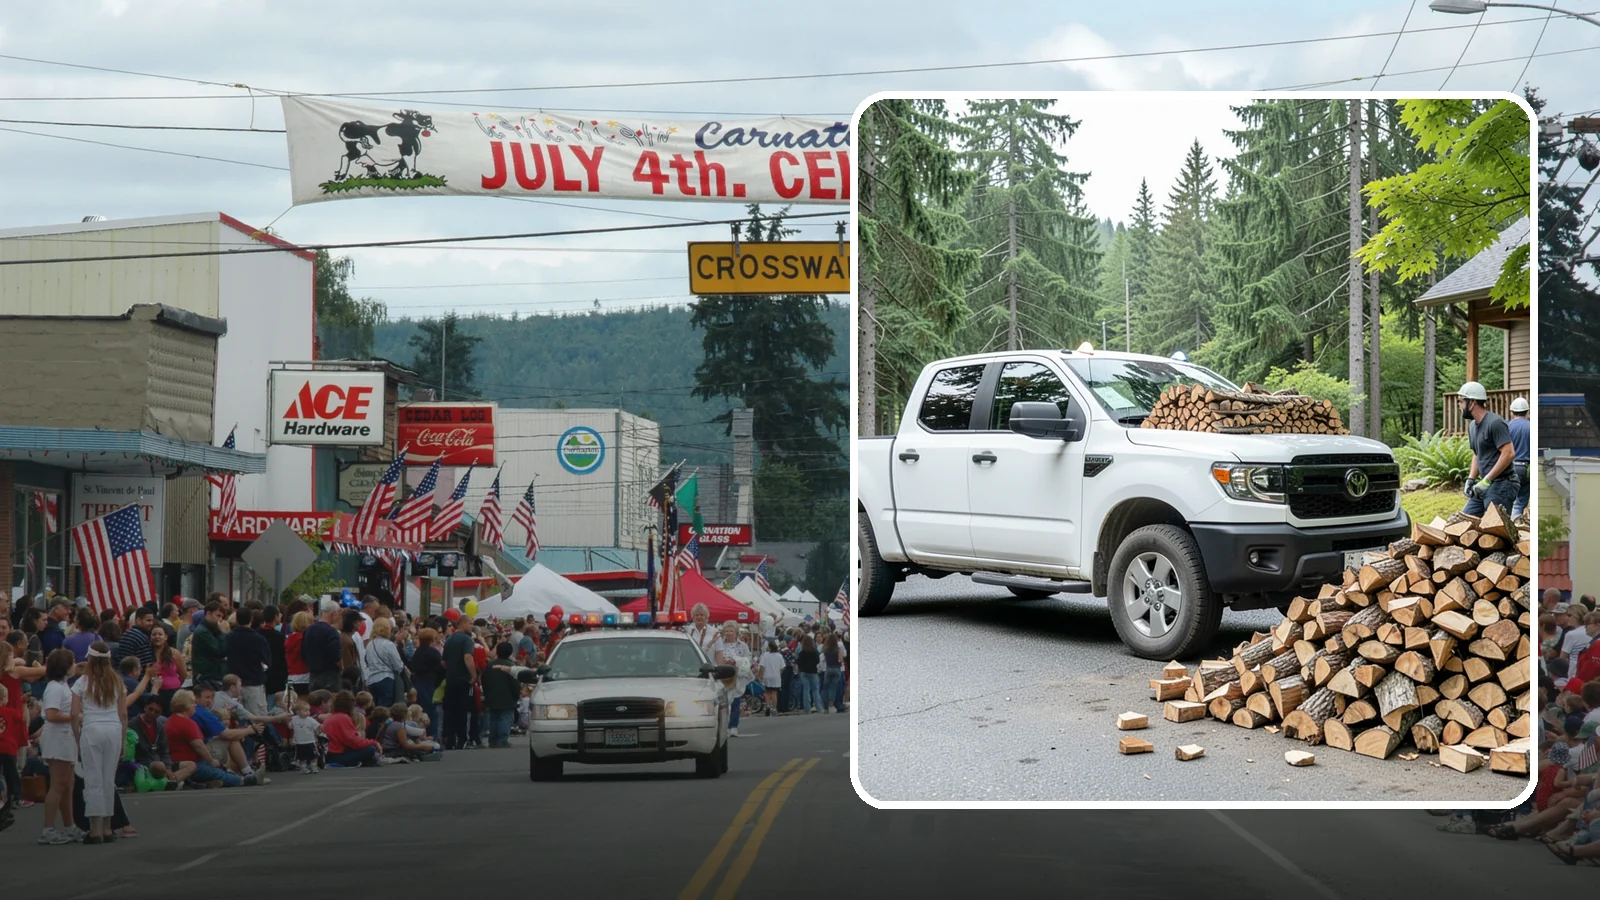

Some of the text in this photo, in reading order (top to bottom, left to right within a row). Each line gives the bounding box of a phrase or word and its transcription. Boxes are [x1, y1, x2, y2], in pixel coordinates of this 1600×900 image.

[481, 140, 605, 191] JULY
[632, 150, 747, 198] 4th.
[697, 254, 850, 280] CROSSWA
[283, 380, 373, 420] ACE
[406, 409, 485, 422] CEDAR LOG
[283, 421, 371, 437] Hardware
[416, 428, 476, 447] Coca-Cola
[95, 485, 124, 495] Vincent
[126, 486, 136, 495] de
[137, 486, 155, 496] Paul
[688, 526, 741, 535] CRNATION
[699, 535, 730, 543] GLASS
